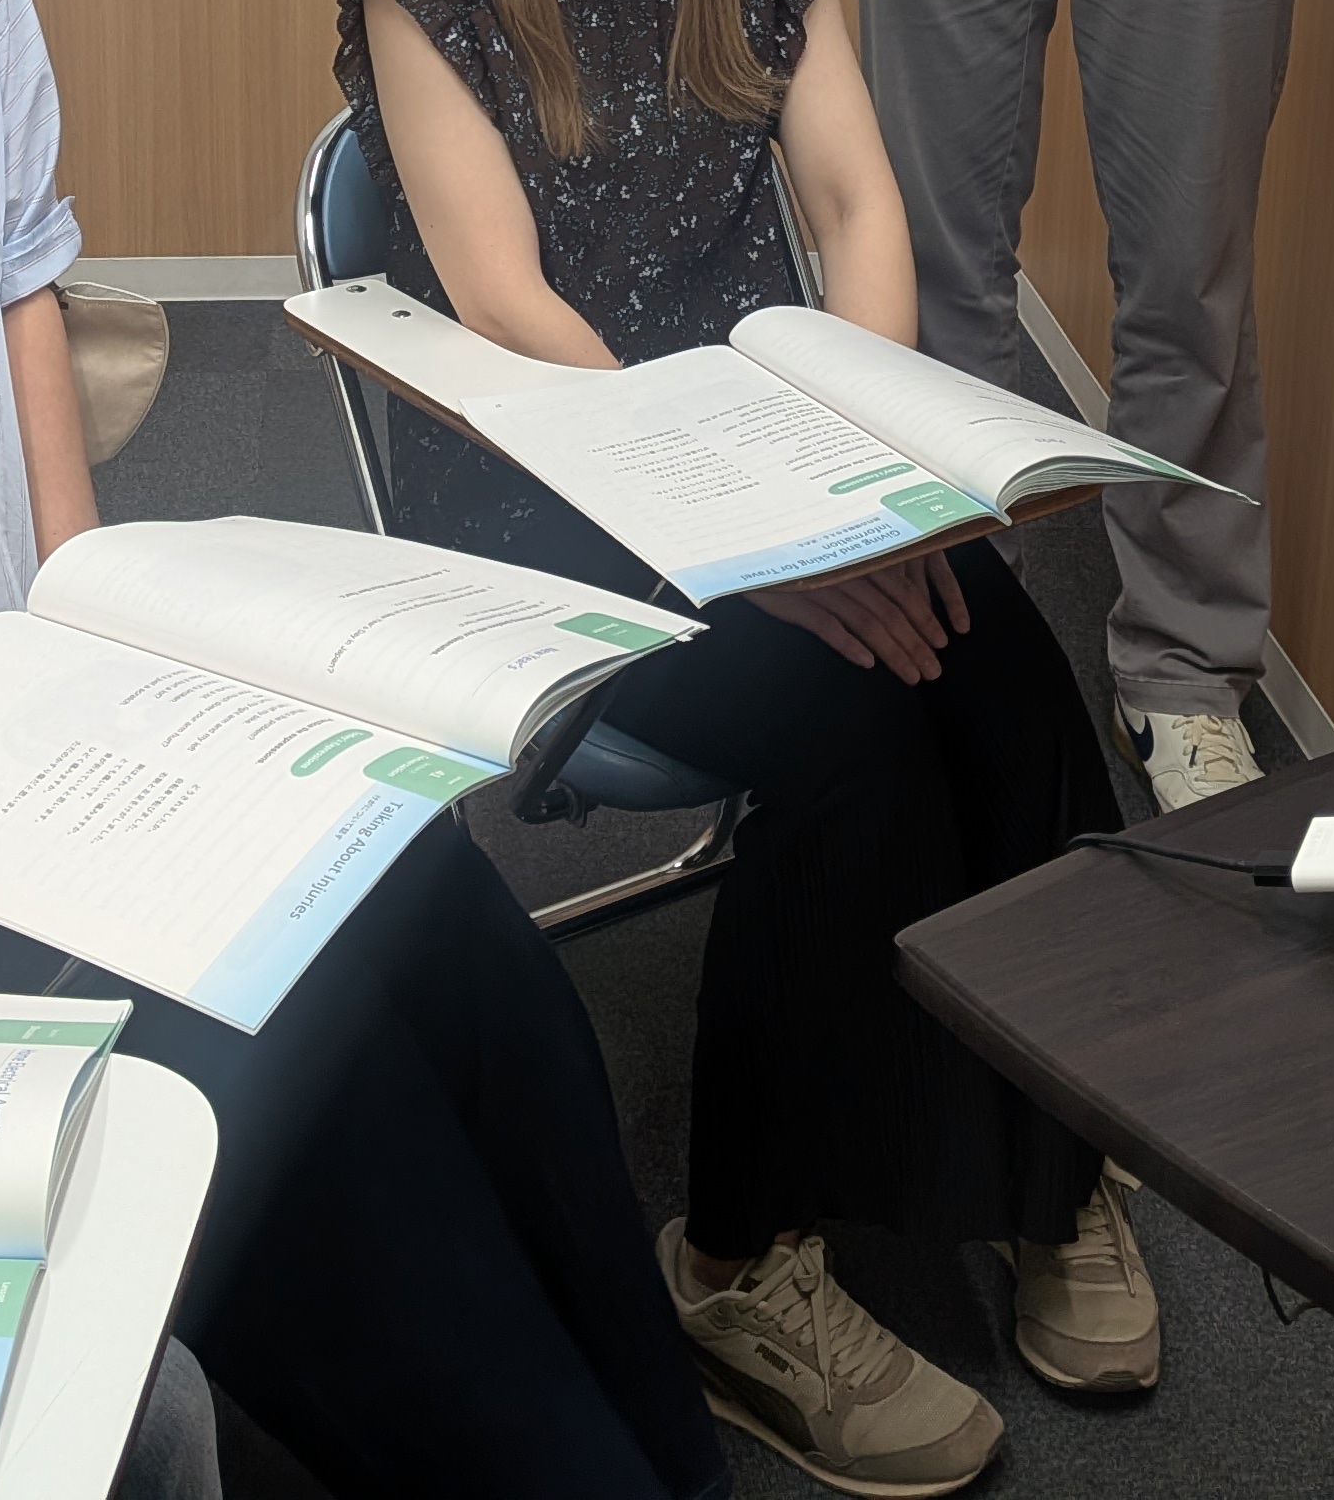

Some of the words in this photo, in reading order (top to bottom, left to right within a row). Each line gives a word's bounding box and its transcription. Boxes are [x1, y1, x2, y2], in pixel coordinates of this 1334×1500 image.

[929, 503, 944, 513] 40
[821, 522, 893, 551] Information
[860, 529, 901, 548] Giving
[839, 541, 863, 555] and
[780, 563, 800, 573] for
[796, 550, 838, 567] Asking
[739, 567, 780, 581] Travel
[334, 794, 381, 841] けがについて話す
[359, 801, 403, 838] Talking
[329, 837, 365, 874] About
[289, 874, 335, 920] Injuries
